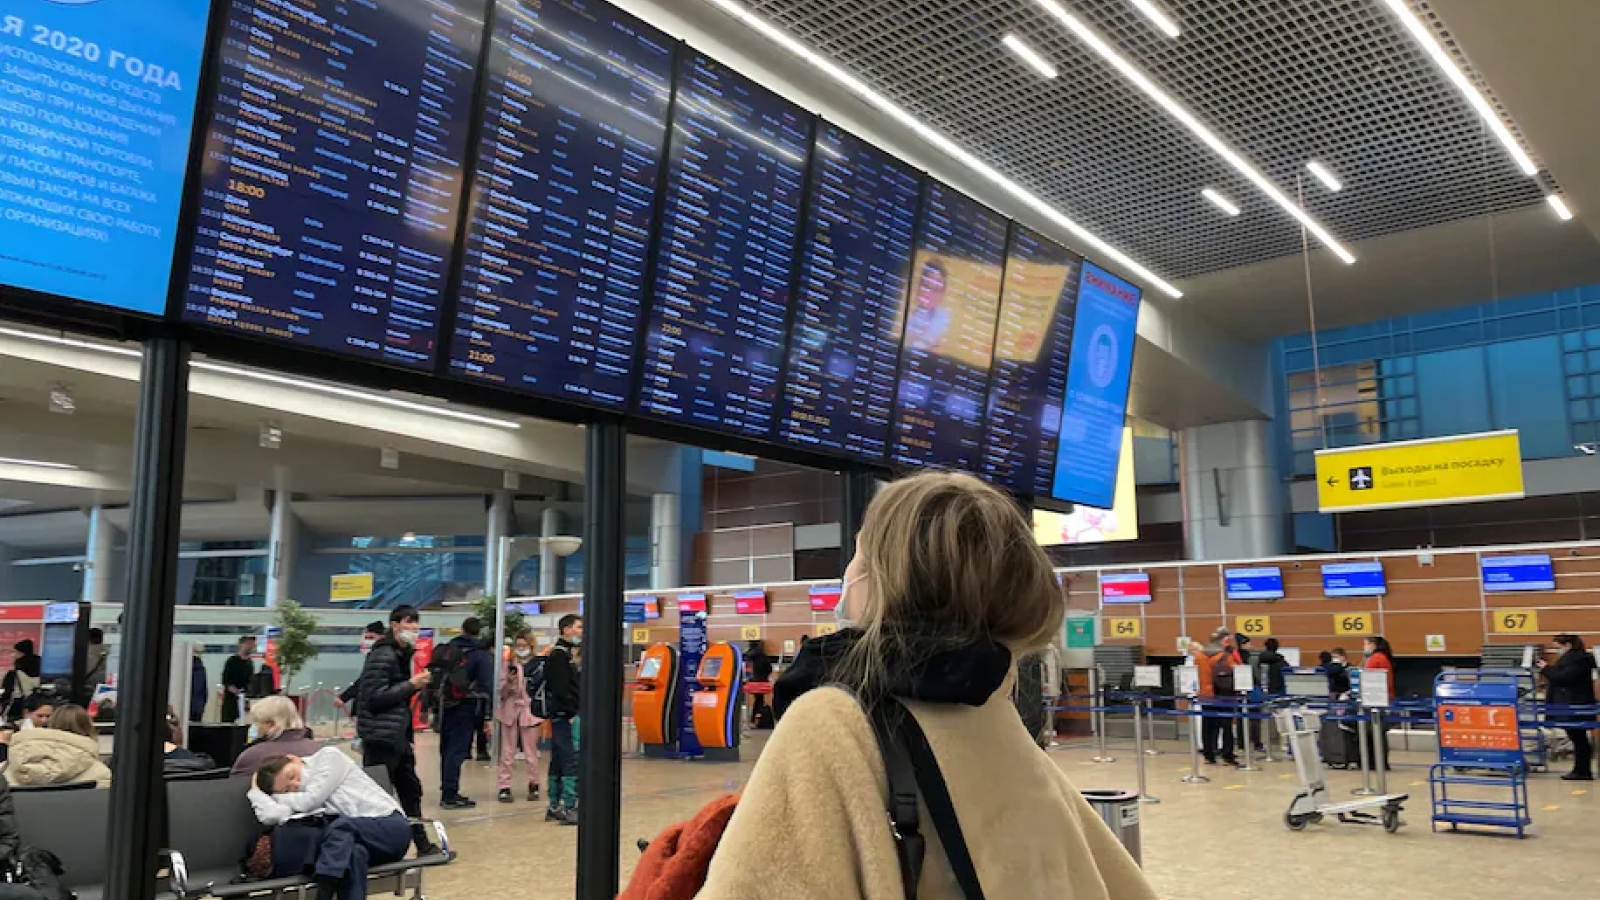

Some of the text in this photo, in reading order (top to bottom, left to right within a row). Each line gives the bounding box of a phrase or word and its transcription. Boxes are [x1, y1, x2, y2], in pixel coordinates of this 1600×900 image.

[30, 24, 101, 63] 2020
[107, 48, 183, 92] ГОДА
[227, 177, 267, 200] 18:00
[1381, 457, 1505, 476] Выходы на посадку
[1117, 620, 1134, 634] 64
[1243, 618, 1264, 632] 65
[1342, 616, 1364, 630] 66
[1503, 613, 1528, 628] 67
